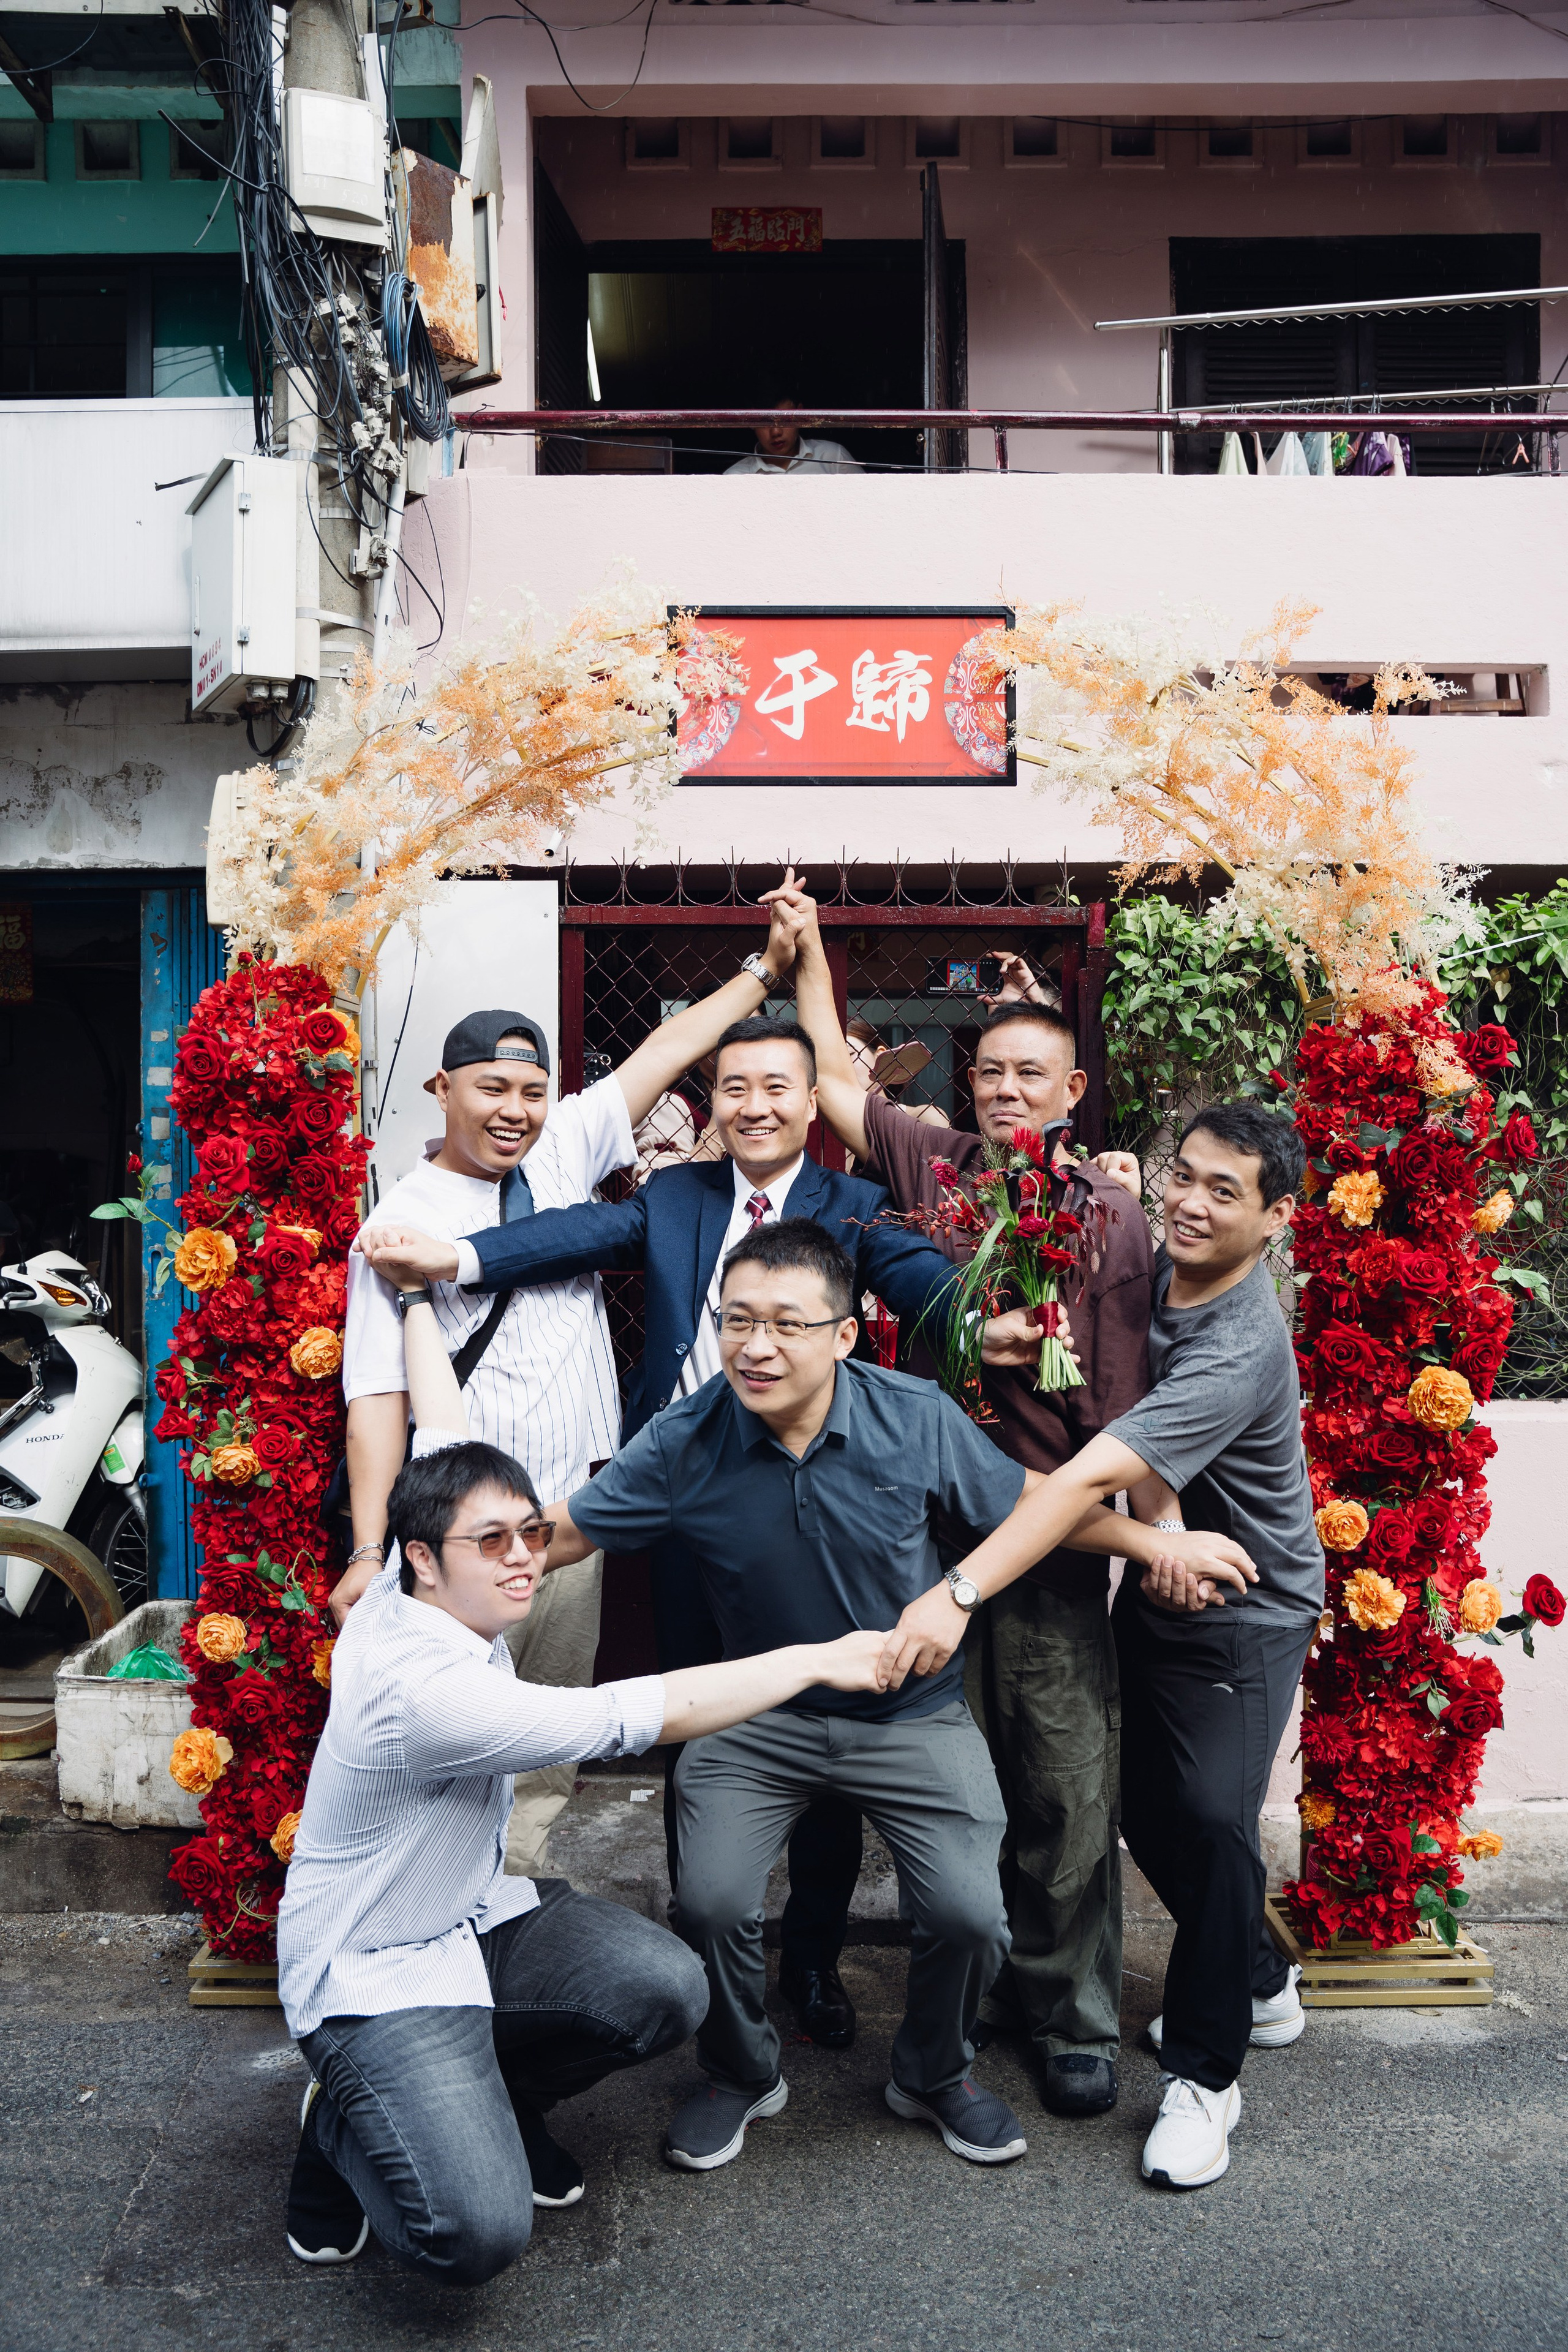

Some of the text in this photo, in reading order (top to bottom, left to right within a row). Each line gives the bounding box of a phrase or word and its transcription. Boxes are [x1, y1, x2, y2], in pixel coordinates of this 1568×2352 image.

[729, 216, 805, 242] 五福臨門
[199, 652, 208, 672] HCM
